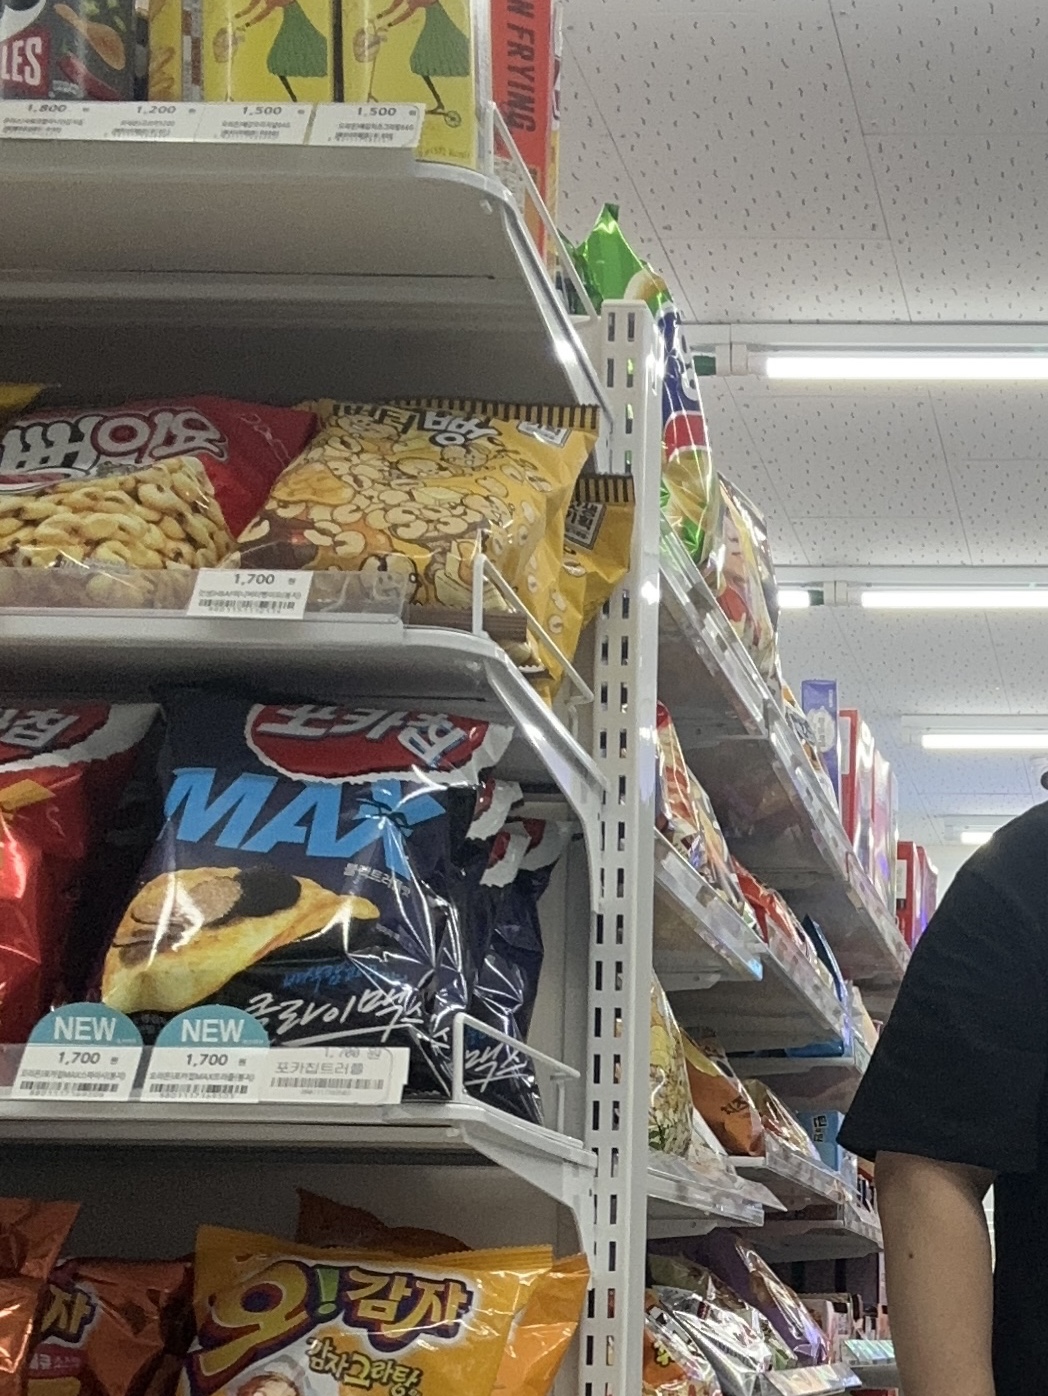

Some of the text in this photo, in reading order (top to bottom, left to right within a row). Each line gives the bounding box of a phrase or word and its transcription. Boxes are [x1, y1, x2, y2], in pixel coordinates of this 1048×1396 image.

[507, 22, 536, 132] FRYING
[137, 105, 176, 114] 1,200
[242, 106, 282, 115] 1,500
[357, 107, 397, 117] 1,500
[234, 573, 275, 585] 1,700
[164, 767, 446, 882] MAX
[54, 1017, 116, 1041] NEW
[181, 1019, 245, 1043] NEW
[58, 1052, 100, 1066] 1,700
[186, 1054, 228, 1067] 1,700
[199, 1262, 468, 1377] 오!감자
